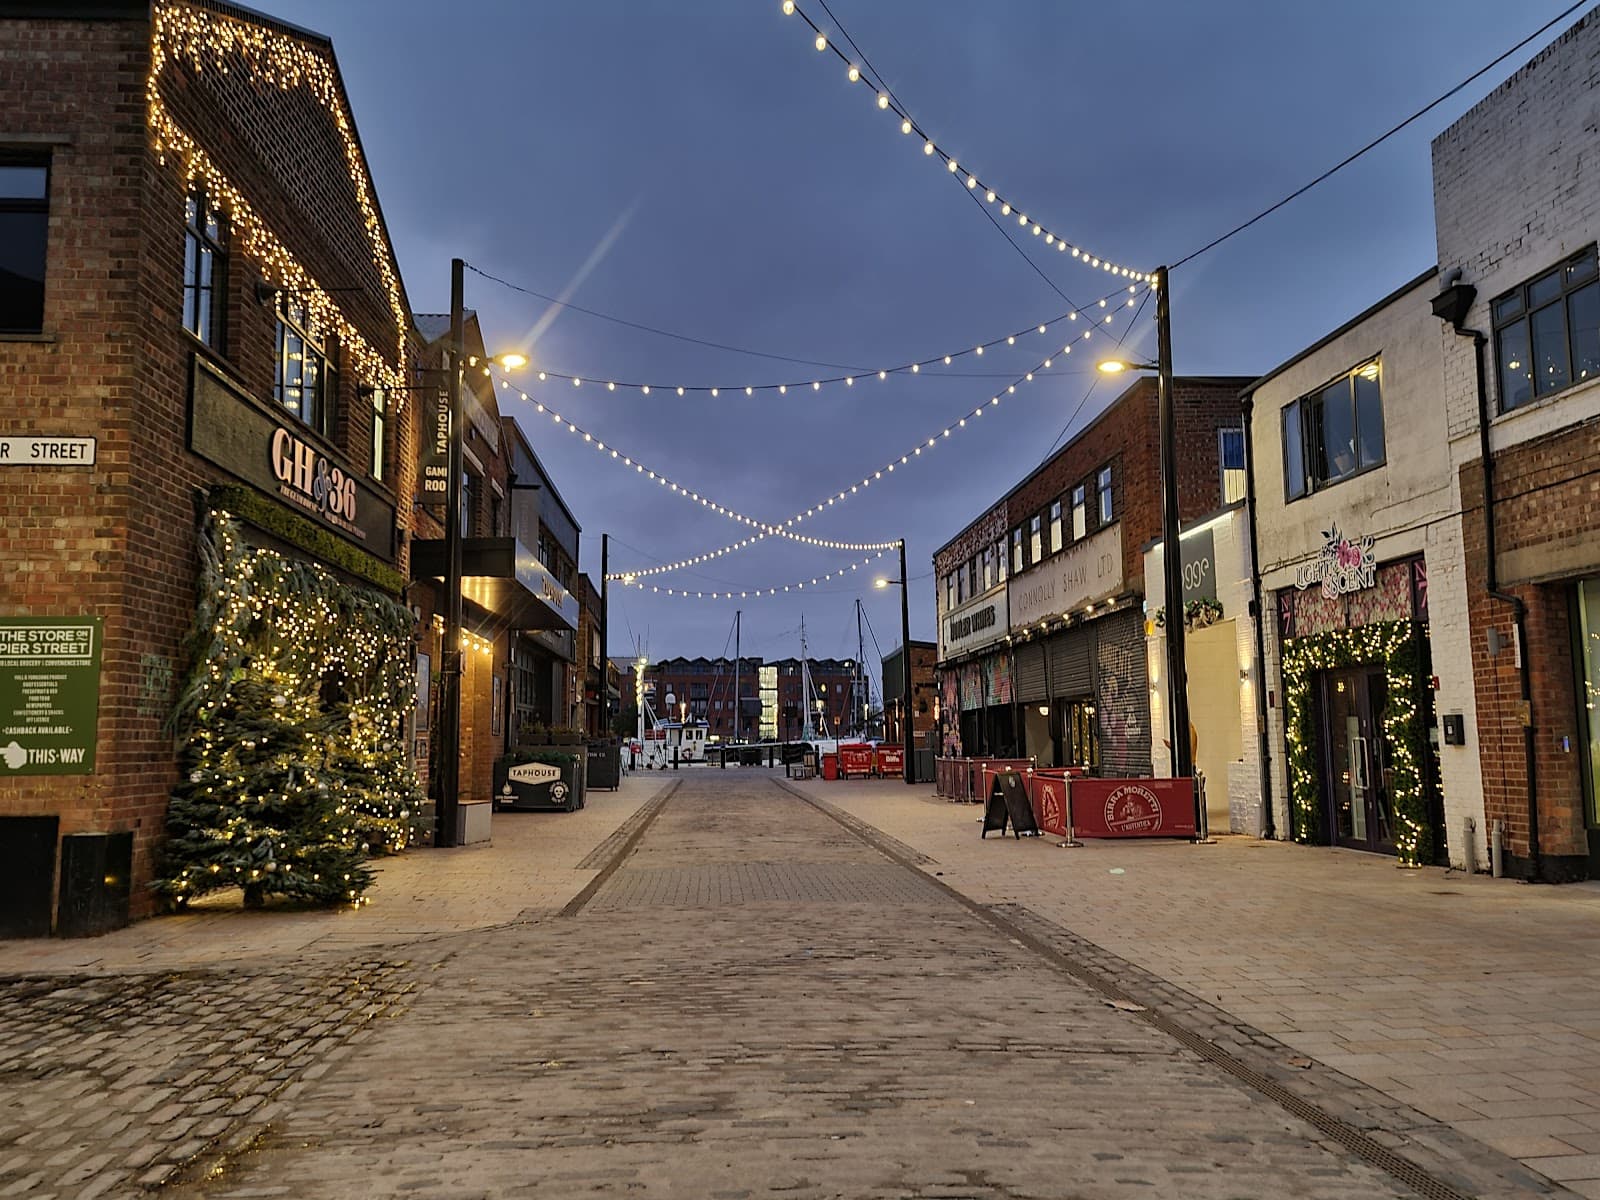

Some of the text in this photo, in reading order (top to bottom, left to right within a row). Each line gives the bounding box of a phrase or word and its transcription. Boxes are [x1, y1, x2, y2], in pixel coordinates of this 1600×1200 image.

[436, 390, 449, 455] TAPHOUSE
[30, 442, 88, 459] STREET
[1063, 565, 1088, 592] SHAW
[1096, 553, 1115, 578] LTD
[971, 604, 996, 633] WHITES
[0, 630, 26, 642] THE
[28, 630, 75, 642] STORE
[0, 643, 88, 654] PIER STREET
[5, 726, 70, 734] CASHBACK AVAILABLE
[59, 748, 86, 764] WAY
[512, 769, 557, 777] TAPHOUSE
[1107, 785, 1158, 821] BIRRA MORETTI
